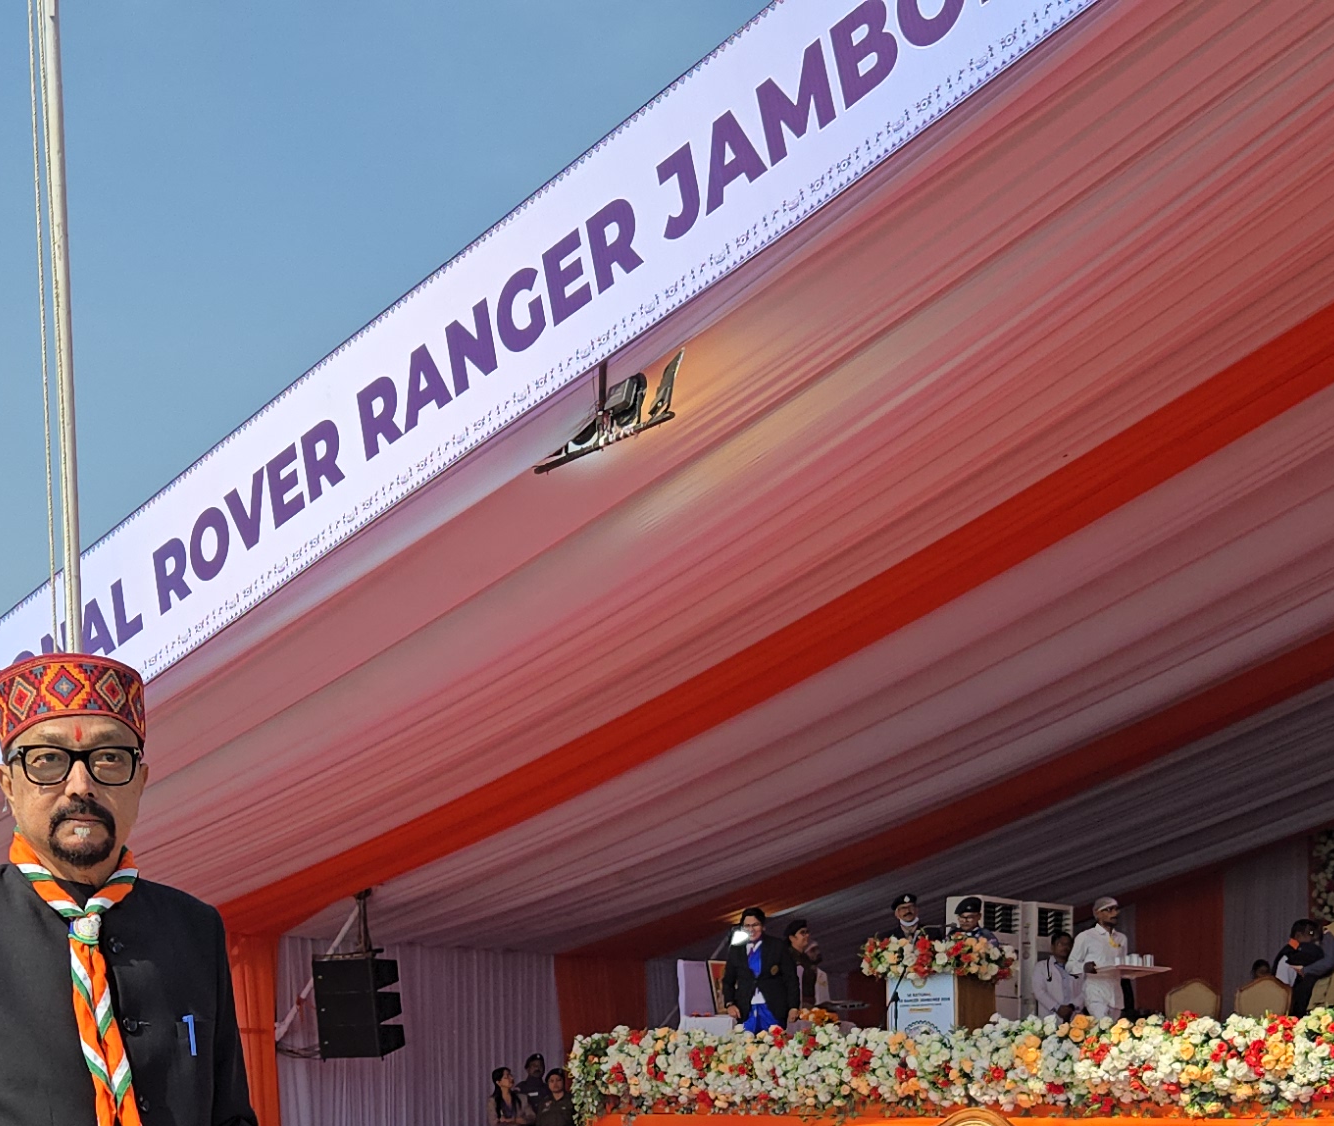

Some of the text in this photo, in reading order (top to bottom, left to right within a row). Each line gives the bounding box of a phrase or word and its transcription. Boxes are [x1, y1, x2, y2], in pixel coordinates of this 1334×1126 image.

[152, 419, 346, 616] ROVER
[356, 198, 645, 462] RANGER
[656, 0, 990, 240] JAMBO
